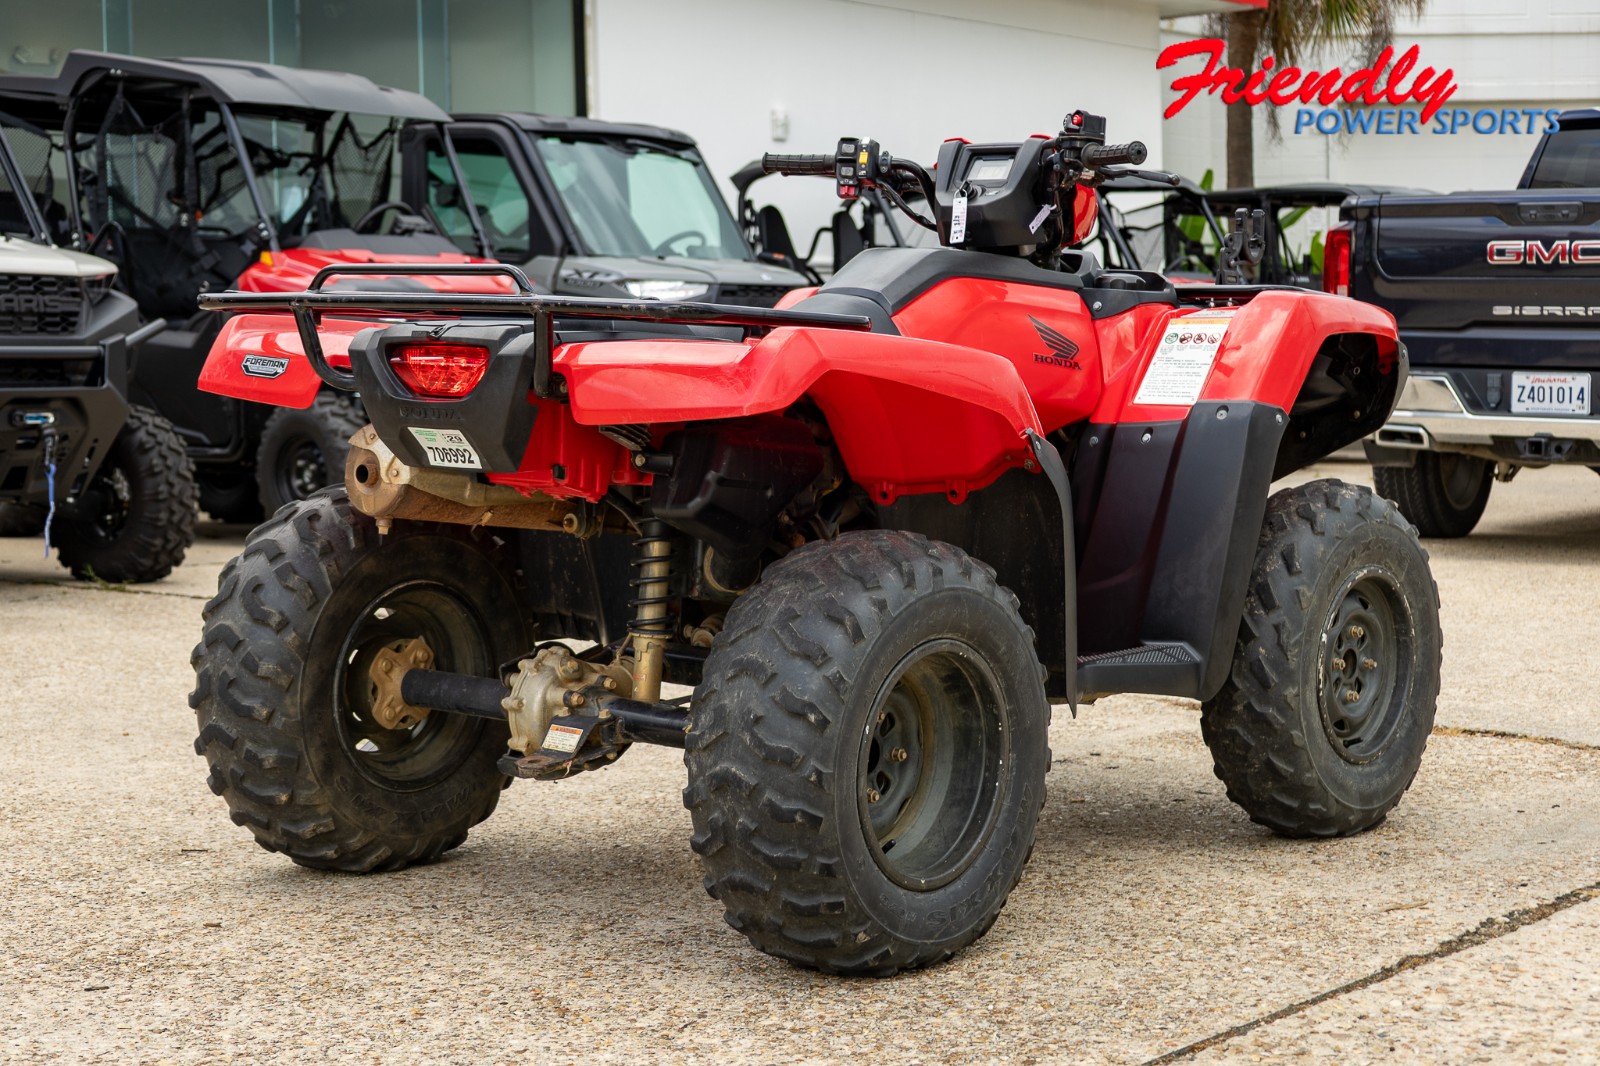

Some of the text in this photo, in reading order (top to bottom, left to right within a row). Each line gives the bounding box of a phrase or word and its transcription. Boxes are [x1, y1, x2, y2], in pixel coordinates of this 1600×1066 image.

[1487, 240, 1600, 265] GMC
[244, 357, 286, 368] FOREMAN
[1033, 353, 1082, 370] HONDA
[1517, 385, 1585, 404] Z401014
[447, 435, 463, 443] 29
[426, 446, 476, 465] 706992
